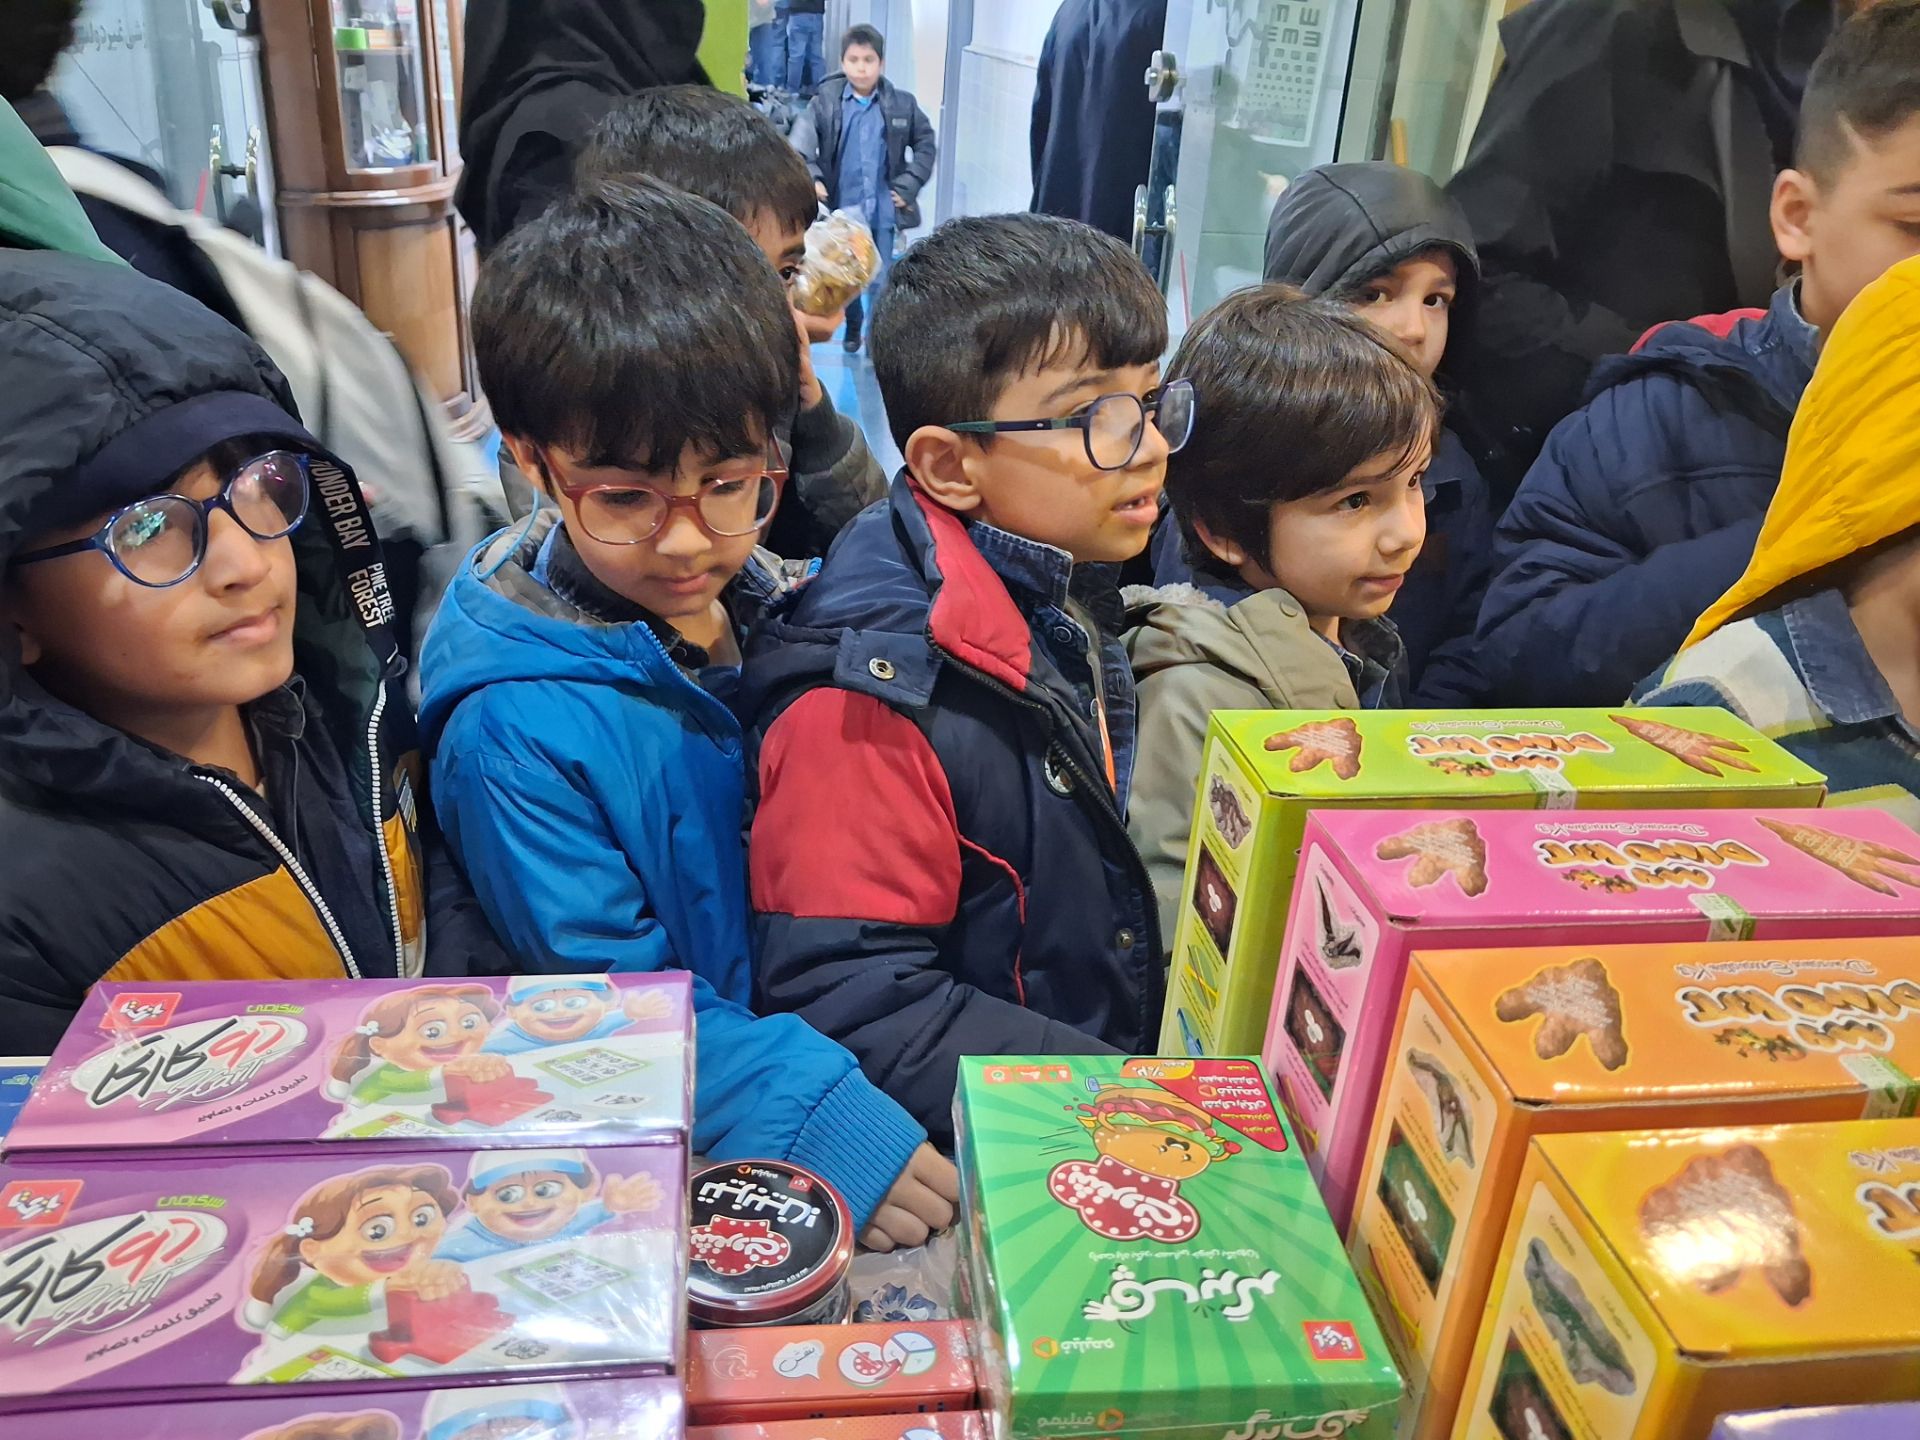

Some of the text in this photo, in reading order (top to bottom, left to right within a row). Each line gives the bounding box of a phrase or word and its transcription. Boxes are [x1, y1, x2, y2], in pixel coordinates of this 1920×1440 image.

[334, 514, 371, 550] BAY
[347, 568, 385, 628] FOREST
[368, 562, 396, 625] PINE TREE
[1486, 733, 1611, 755] DINO
[1622, 841, 1764, 868] DINO
[246, 1003, 304, 1015] سرگرمی
[197, 1074, 308, 1124] تطبیق کلمات و تصاویر
[1217, 1087, 1262, 1098] فیلیمو
[1202, 1100, 1267, 1112] اشتراک رایگان
[751, 1169, 779, 1180] فیلیمو
[156, 1194, 228, 1208] سرگرمی
[1088, 1251, 1115, 1262] راحت
[1115, 1250, 1130, 1261] یاد
[1153, 1249, 1190, 1261] حسابی
[1191, 1249, 1221, 1261] خوش
[1080, 1263, 1281, 1323] چک برگر
[84, 1291, 223, 1362] تطبیق کلمات و تصاویر
[1060, 1337, 1116, 1356] فیلیمو
[1037, 1411, 1094, 1429] فیلیمو
